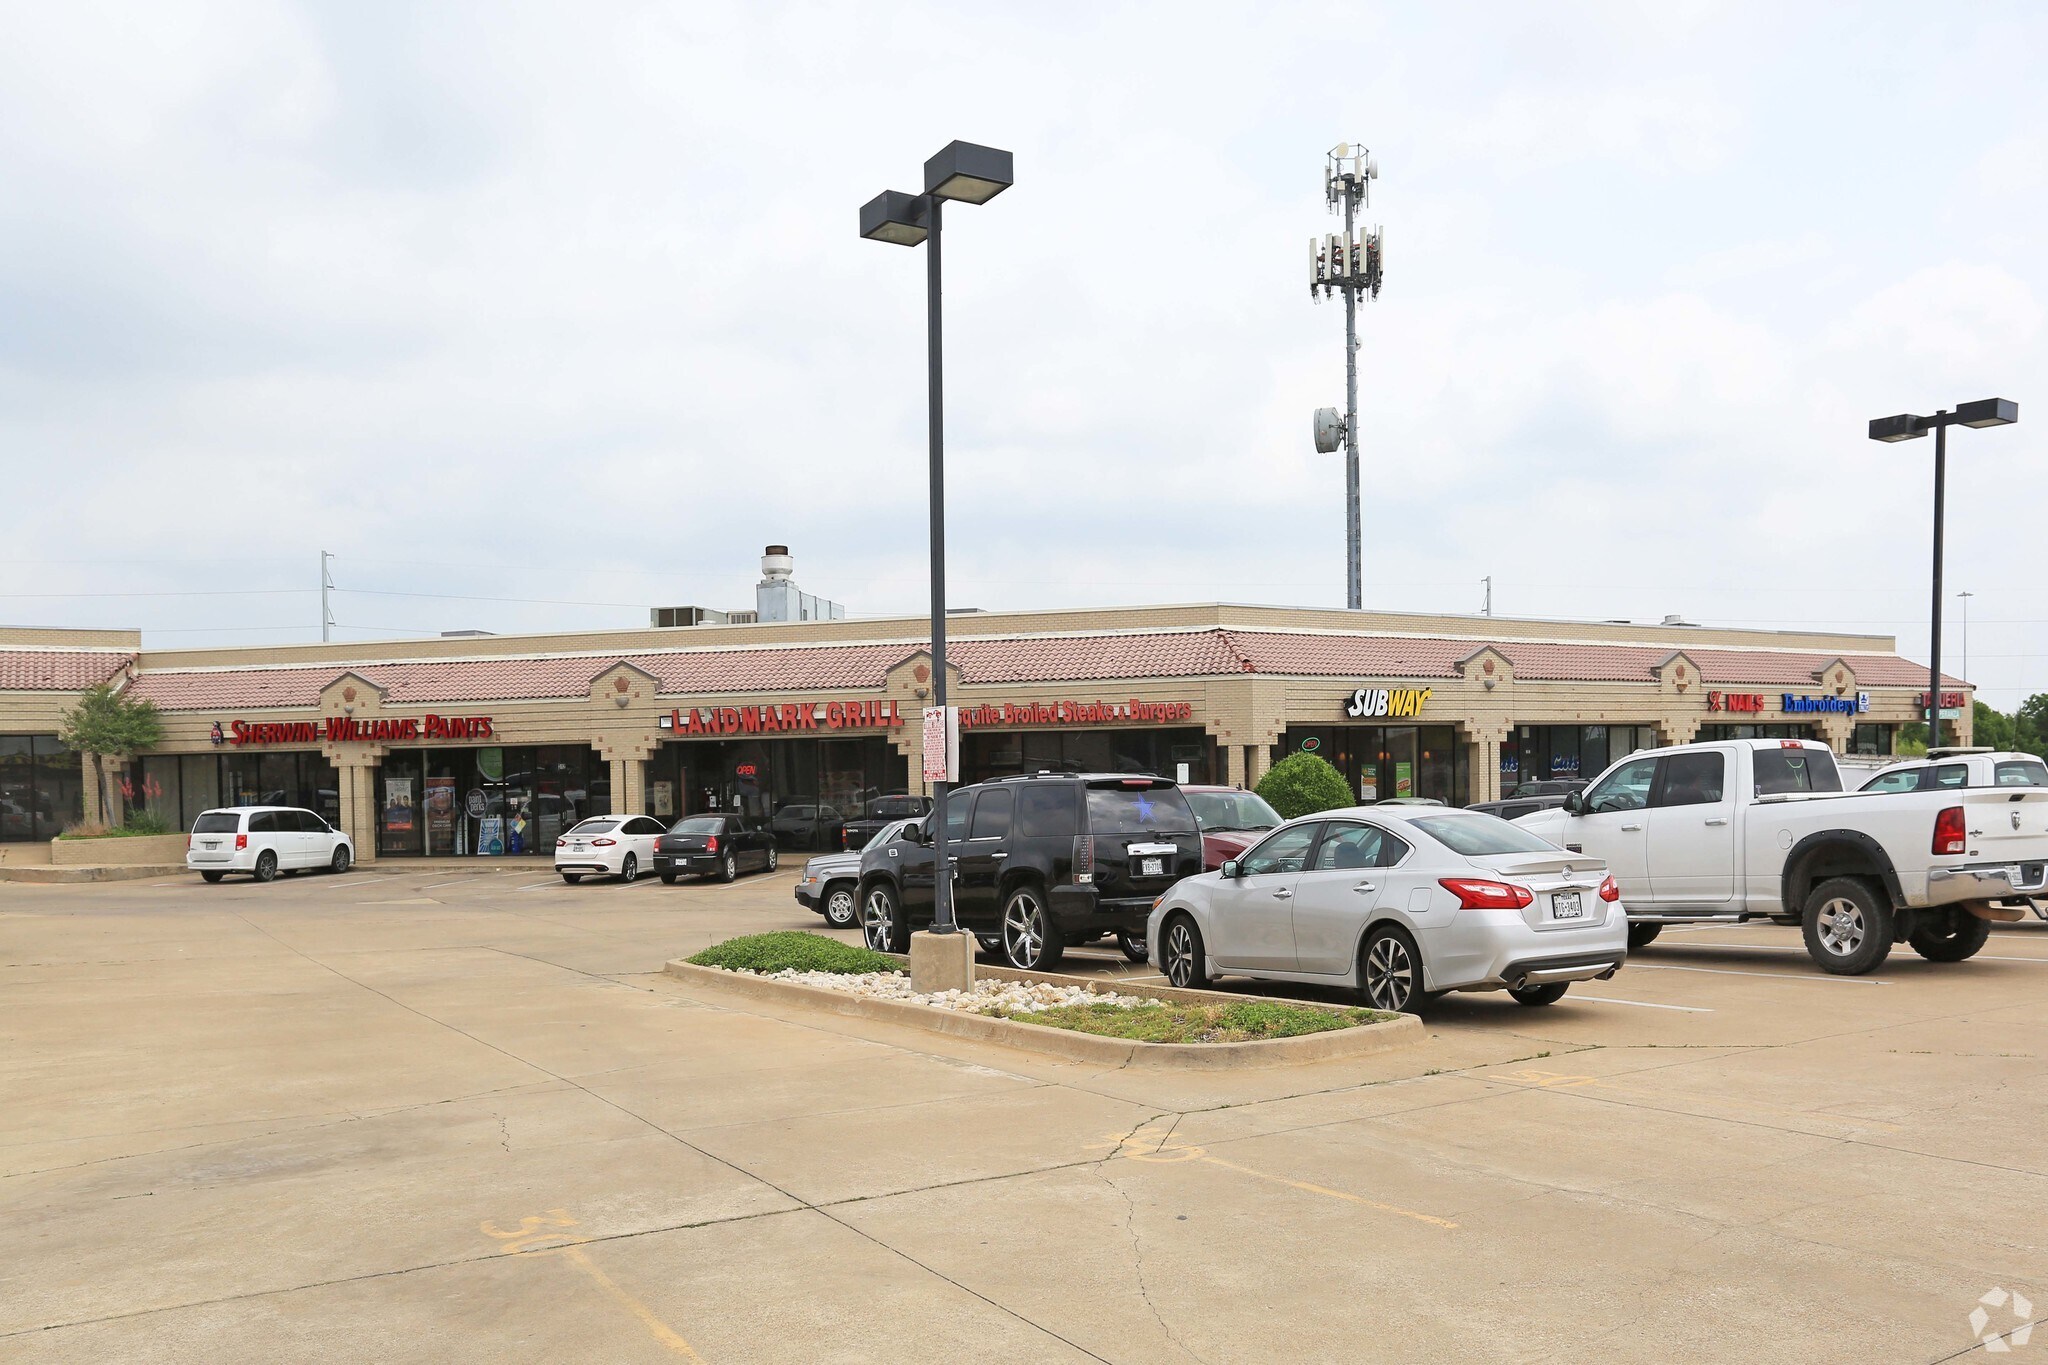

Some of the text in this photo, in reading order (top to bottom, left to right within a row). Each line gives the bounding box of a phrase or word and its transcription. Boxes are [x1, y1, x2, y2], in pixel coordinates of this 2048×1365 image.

[1347, 688, 1432, 717] SUBWAY
[1727, 694, 1764, 711] NAILS
[1783, 693, 1857, 716] Embroidery
[1922, 692, 1966, 707] TAUERIA
[671, 699, 906, 735] LANDMARK GRILL
[957, 698, 1192, 728] squite Broiled Steaks & Burgers
[230, 714, 495, 745] SHERWIN-WILLIAMS PAINTS
[736, 765, 756, 775] OPEN
[1550, 752, 1580, 772] Cuts
[468, 795, 482, 805] paint
[470, 803, 485, 813] perks
